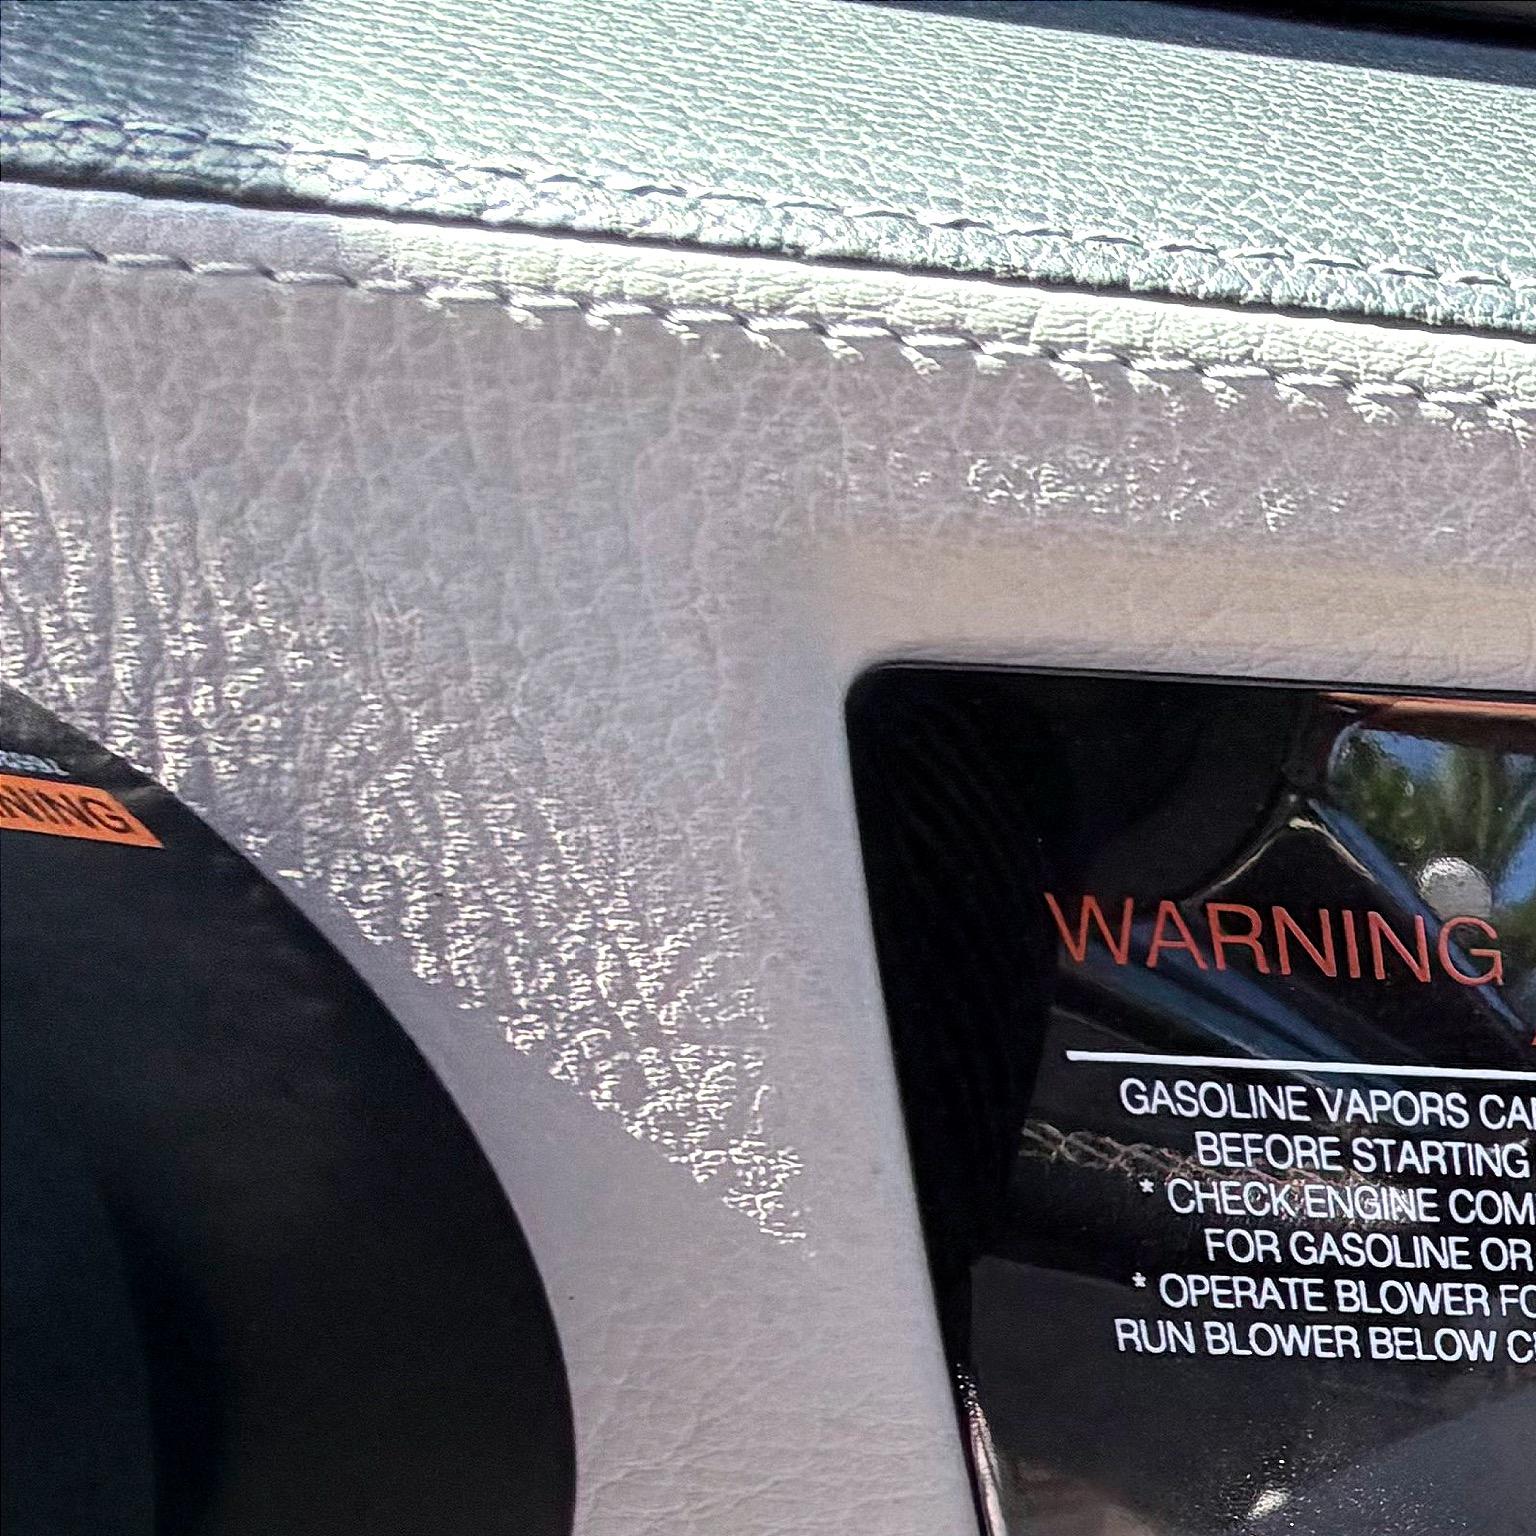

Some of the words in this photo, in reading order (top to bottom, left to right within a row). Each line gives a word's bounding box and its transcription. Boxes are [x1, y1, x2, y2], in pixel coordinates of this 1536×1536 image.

[0, 784, 135, 834] NING
[1047, 895, 1502, 984] WARNING
[1120, 1077, 1311, 1122] GASOLINE
[1315, 1087, 1470, 1129] VAPORS
[1194, 1131, 1344, 1172] BEFORE
[1351, 1136, 1530, 1179] STARTING
[1167, 1177, 1291, 1218] CHECK
[1303, 1182, 1441, 1223] ENGINE
[1204, 1228, 1282, 1263] FOR
[1289, 1230, 1473, 1270] GASOLINE
[1480, 1237, 1534, 1272] OR
[1159, 1273, 1328, 1312] OPERATE
[1334, 1279, 1491, 1317] BLOWER
[1114, 1318, 1196, 1354] RUN
[1203, 1321, 1361, 1359] BLOWER
[1368, 1326, 1497, 1362] BELOW
